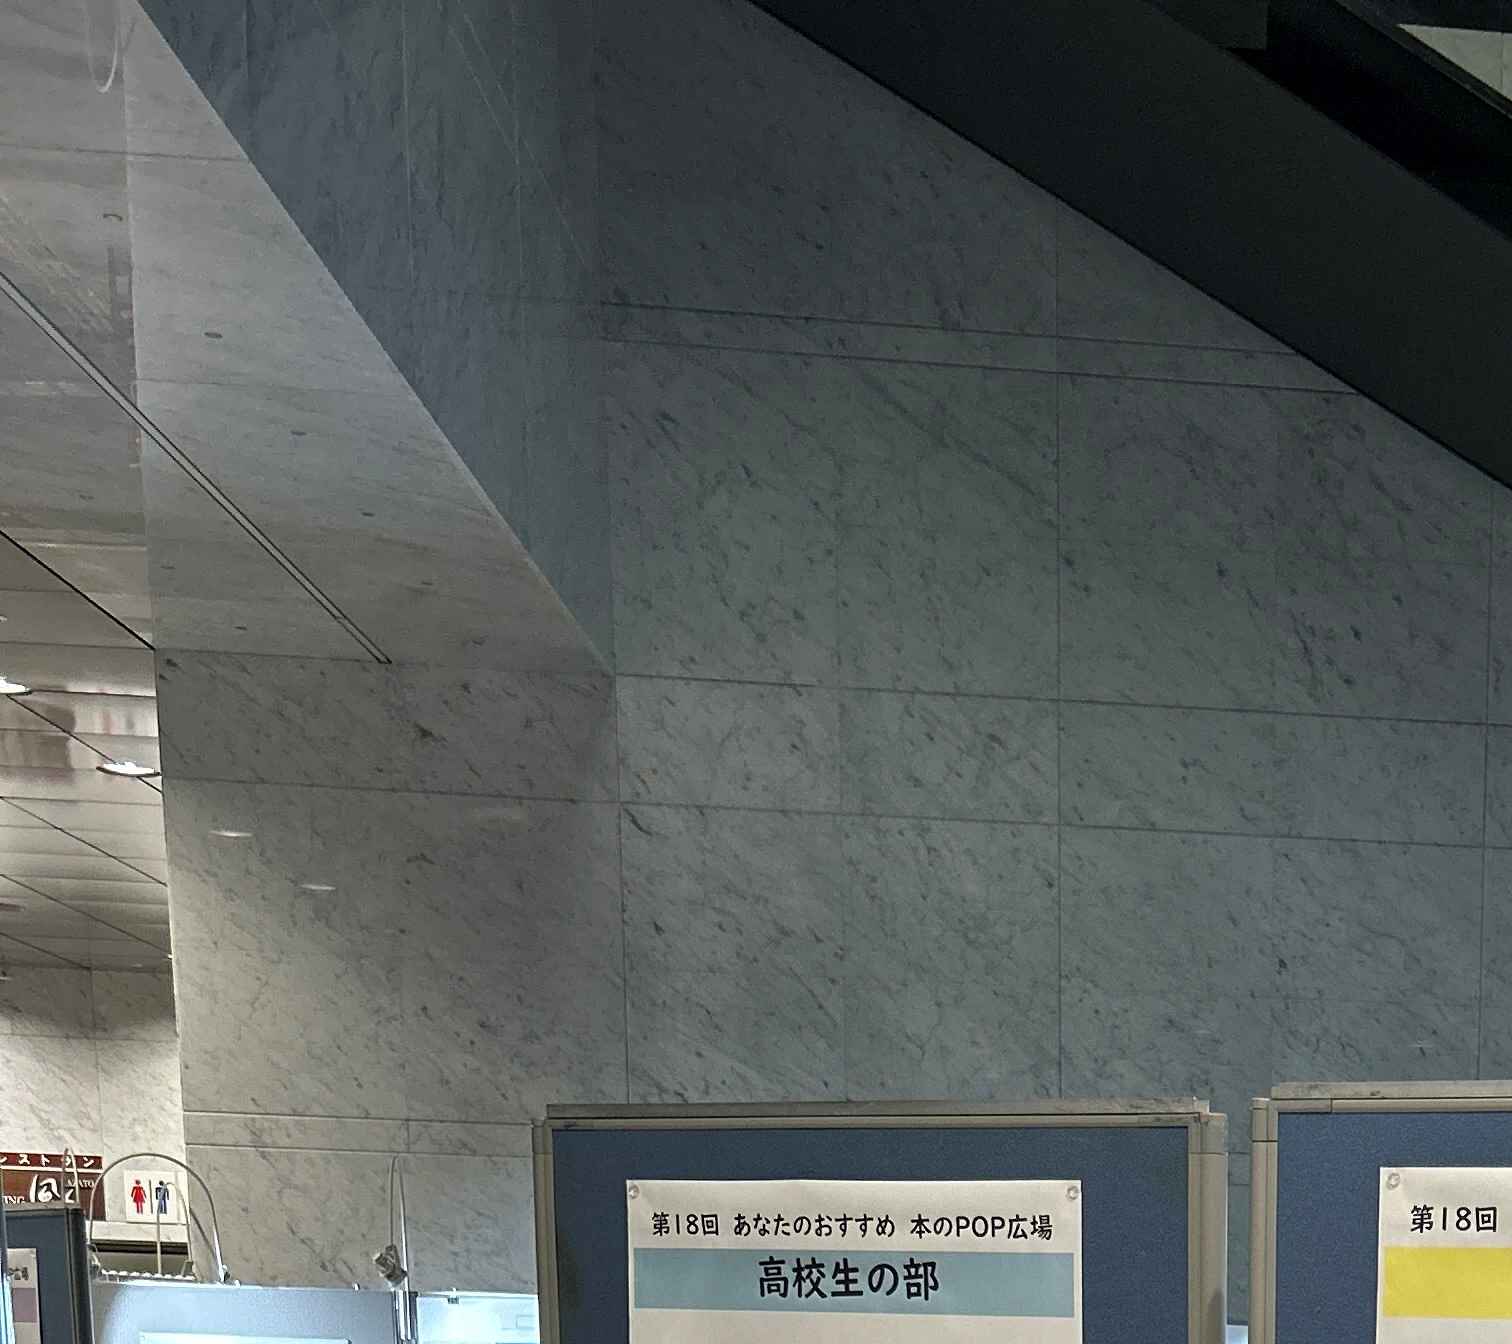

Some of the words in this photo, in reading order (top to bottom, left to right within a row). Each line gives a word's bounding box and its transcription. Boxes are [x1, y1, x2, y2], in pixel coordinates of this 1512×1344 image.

[651, 1212, 720, 1238] 第18回
[733, 1212, 896, 1239] あなたのおすすめ
[910, 1213, 1054, 1242] 本のPOP広場
[1409, 1203, 1499, 1234] 第18回
[758, 1255, 940, 1301] 高校生の部
